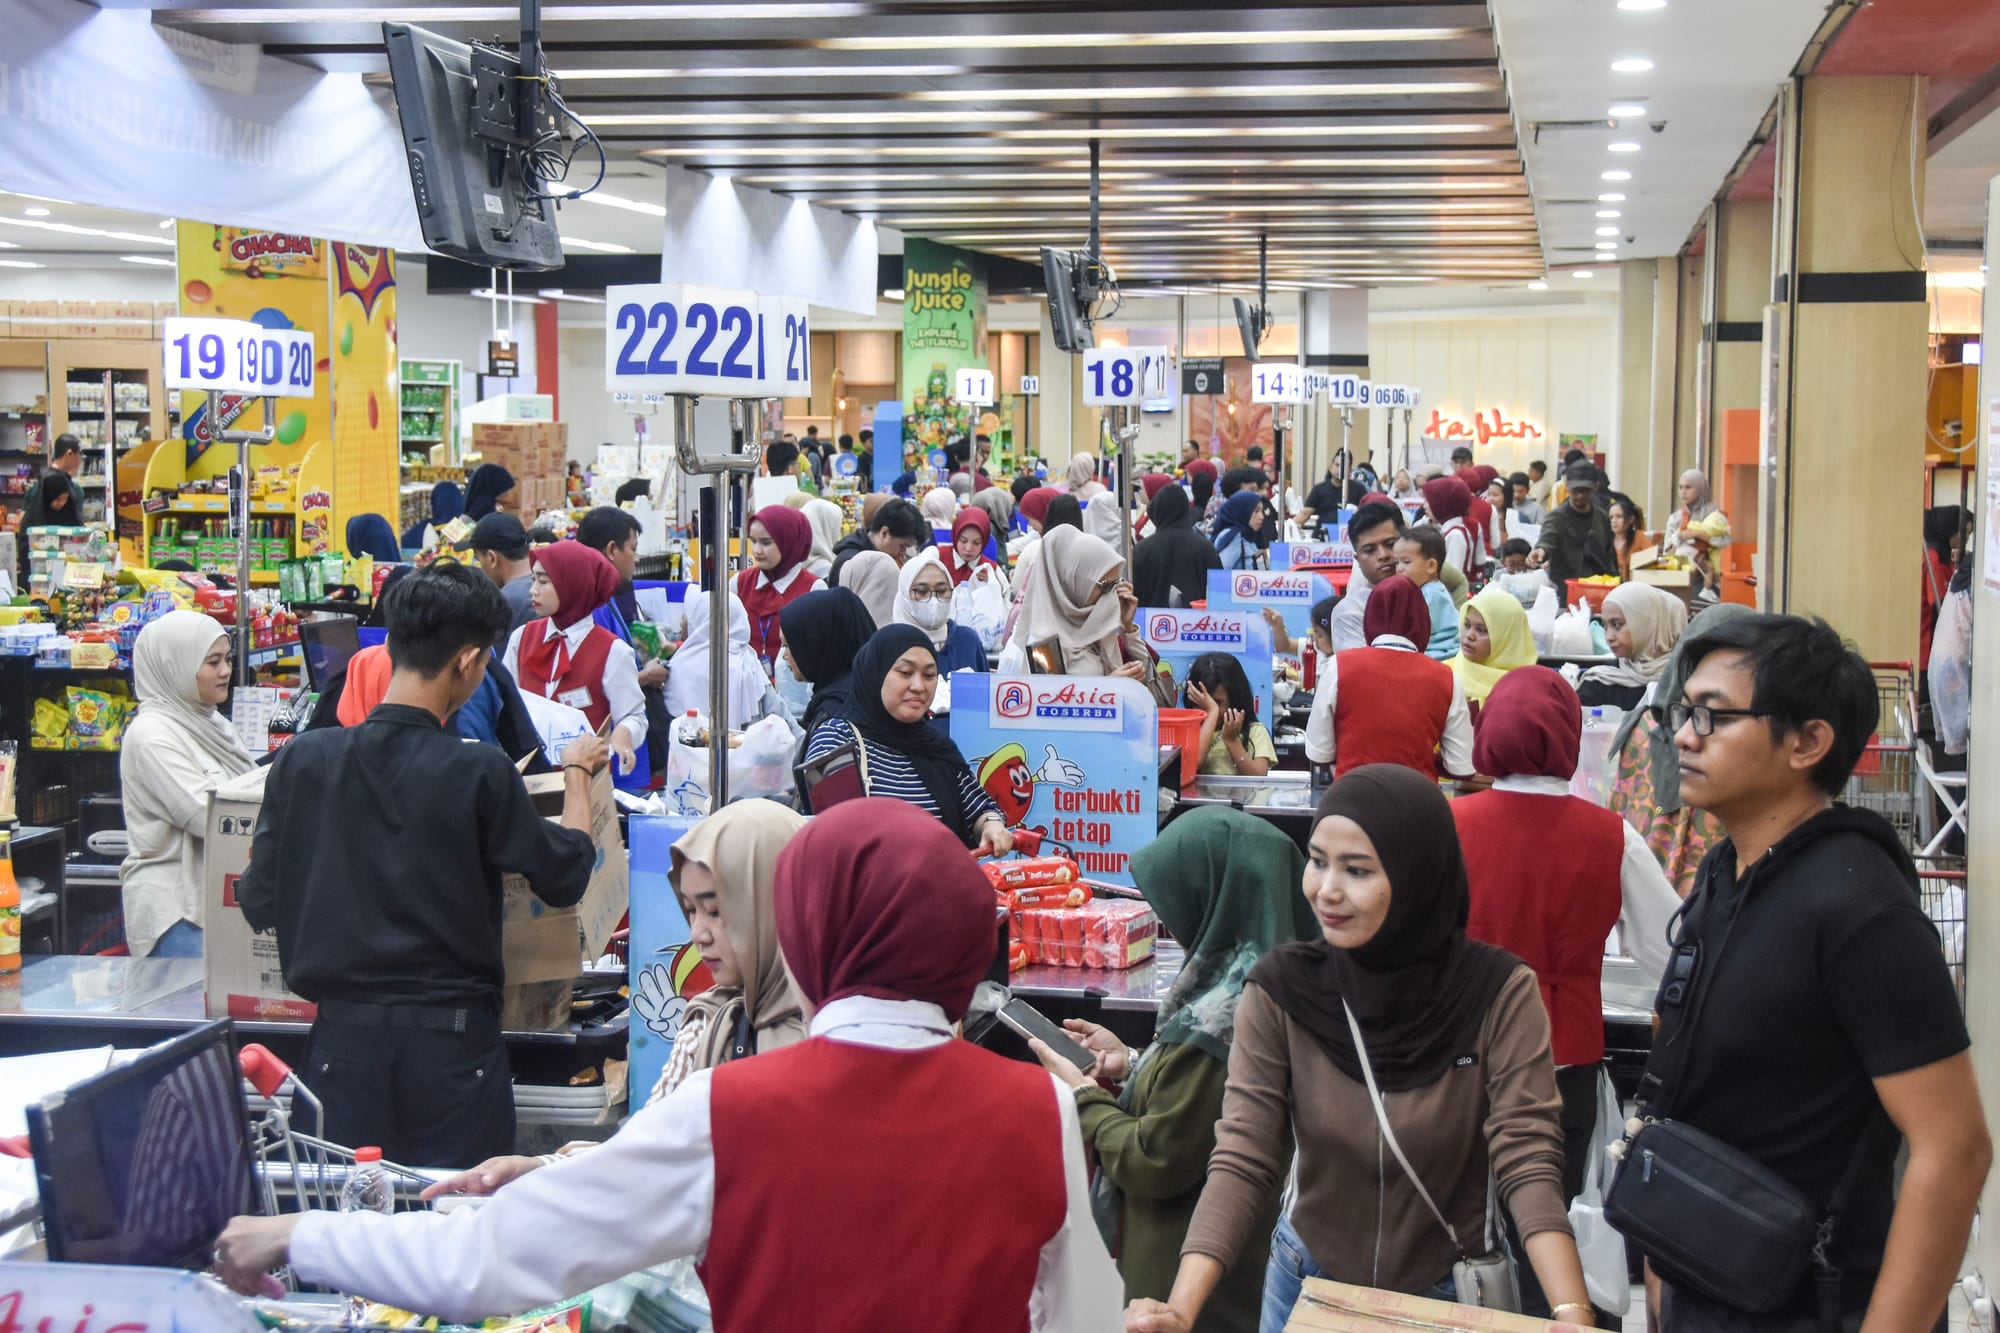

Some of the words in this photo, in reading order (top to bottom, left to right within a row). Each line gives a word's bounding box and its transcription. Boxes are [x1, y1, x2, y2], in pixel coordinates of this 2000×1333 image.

[231, 233, 313, 261] CHACHA
[906, 267, 972, 293] Jungle
[912, 290, 964, 314] Juice
[616, 302, 678, 375] 22
[685, 303, 753, 379] 22
[785, 313, 809, 381] 21
[173, 333, 226, 380] 19
[237, 337, 258, 384] 19
[289, 341, 312, 387] 20
[965, 377, 986, 396] 11
[1024, 379, 1036, 391] 01
[1087, 359, 1133, 397] 18
[1256, 372, 1284, 396] 14
[1304, 375, 1313, 399] 13
[1331, 379, 1354, 398] 10
[1375, 389, 1391, 404] 06
[1392, 388, 1405, 404] 06
[1261, 576, 1309, 589] Asia
[1181, 615, 1240, 632] Asia
[1182, 633, 1239, 641] TOSERBA
[1037, 683, 1116, 705] Asia
[1039, 708, 1113, 717] TOSERBA
[1053, 787, 1140, 814] terbukti
[1052, 817, 1111, 847] tetap
[1006, 872, 1025, 882] Roma
[1021, 895, 1040, 903] Roma
